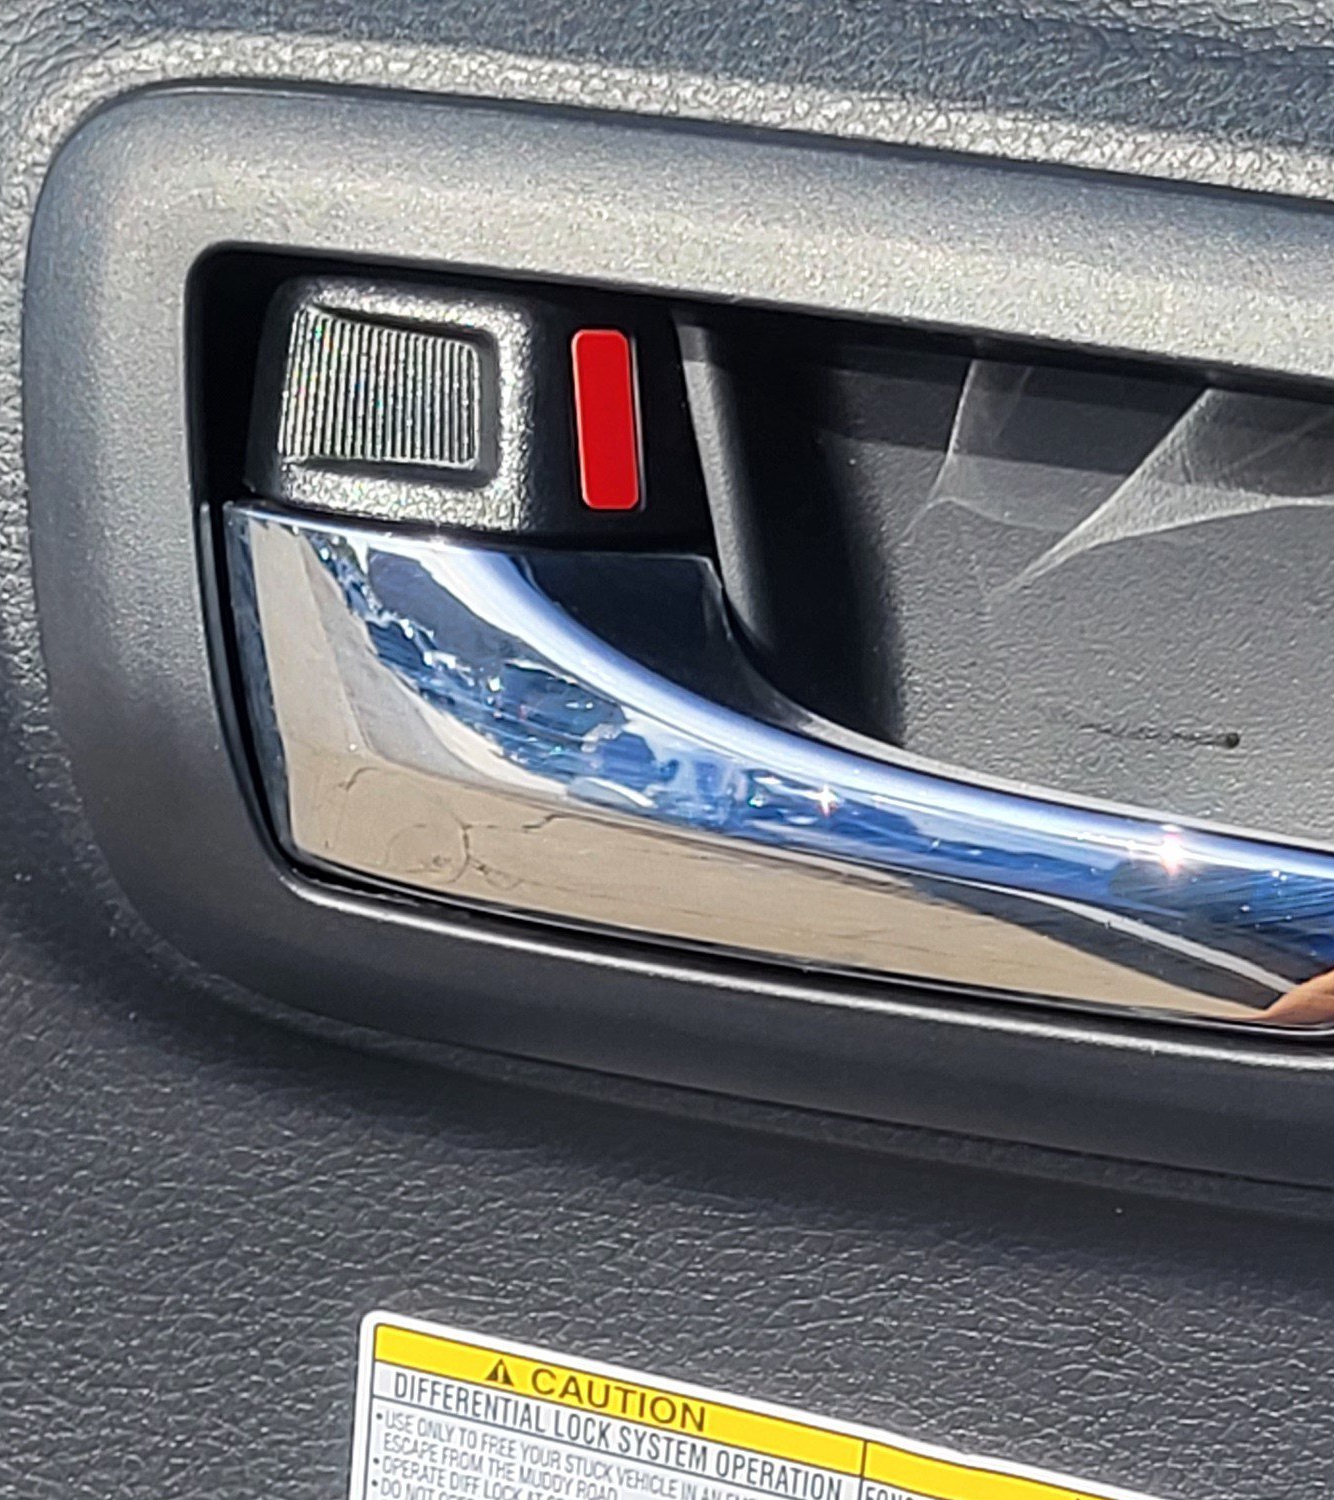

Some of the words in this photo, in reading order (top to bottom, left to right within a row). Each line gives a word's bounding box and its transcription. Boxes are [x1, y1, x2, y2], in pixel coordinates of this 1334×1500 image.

[393, 1371, 546, 1433] DIFFERENTIAL
[553, 1409, 611, 1449] LOCK
[617, 1424, 708, 1472] SYSTEM
[530, 1367, 705, 1432] CAUTION
[381, 1454, 446, 1488] OPERATE
[448, 1470, 481, 1495] DIFF
[382, 1431, 438, 1463] ESCAPE
[440, 1445, 484, 1473] FROM
[487, 1456, 515, 1482] THE
[518, 1464, 574, 1495] MUDDY
[384, 1409, 414, 1434] USE
[416, 1416, 455, 1443] ONLY
[458, 1426, 477, 1449] TO
[480, 1431, 517, 1459] FREE
[519, 1441, 561, 1470] YOUR
[563, 1452, 613, 1483] STUCK
[615, 1465, 678, 1499] VEHICLE
[379, 1476, 402, 1499] DO
